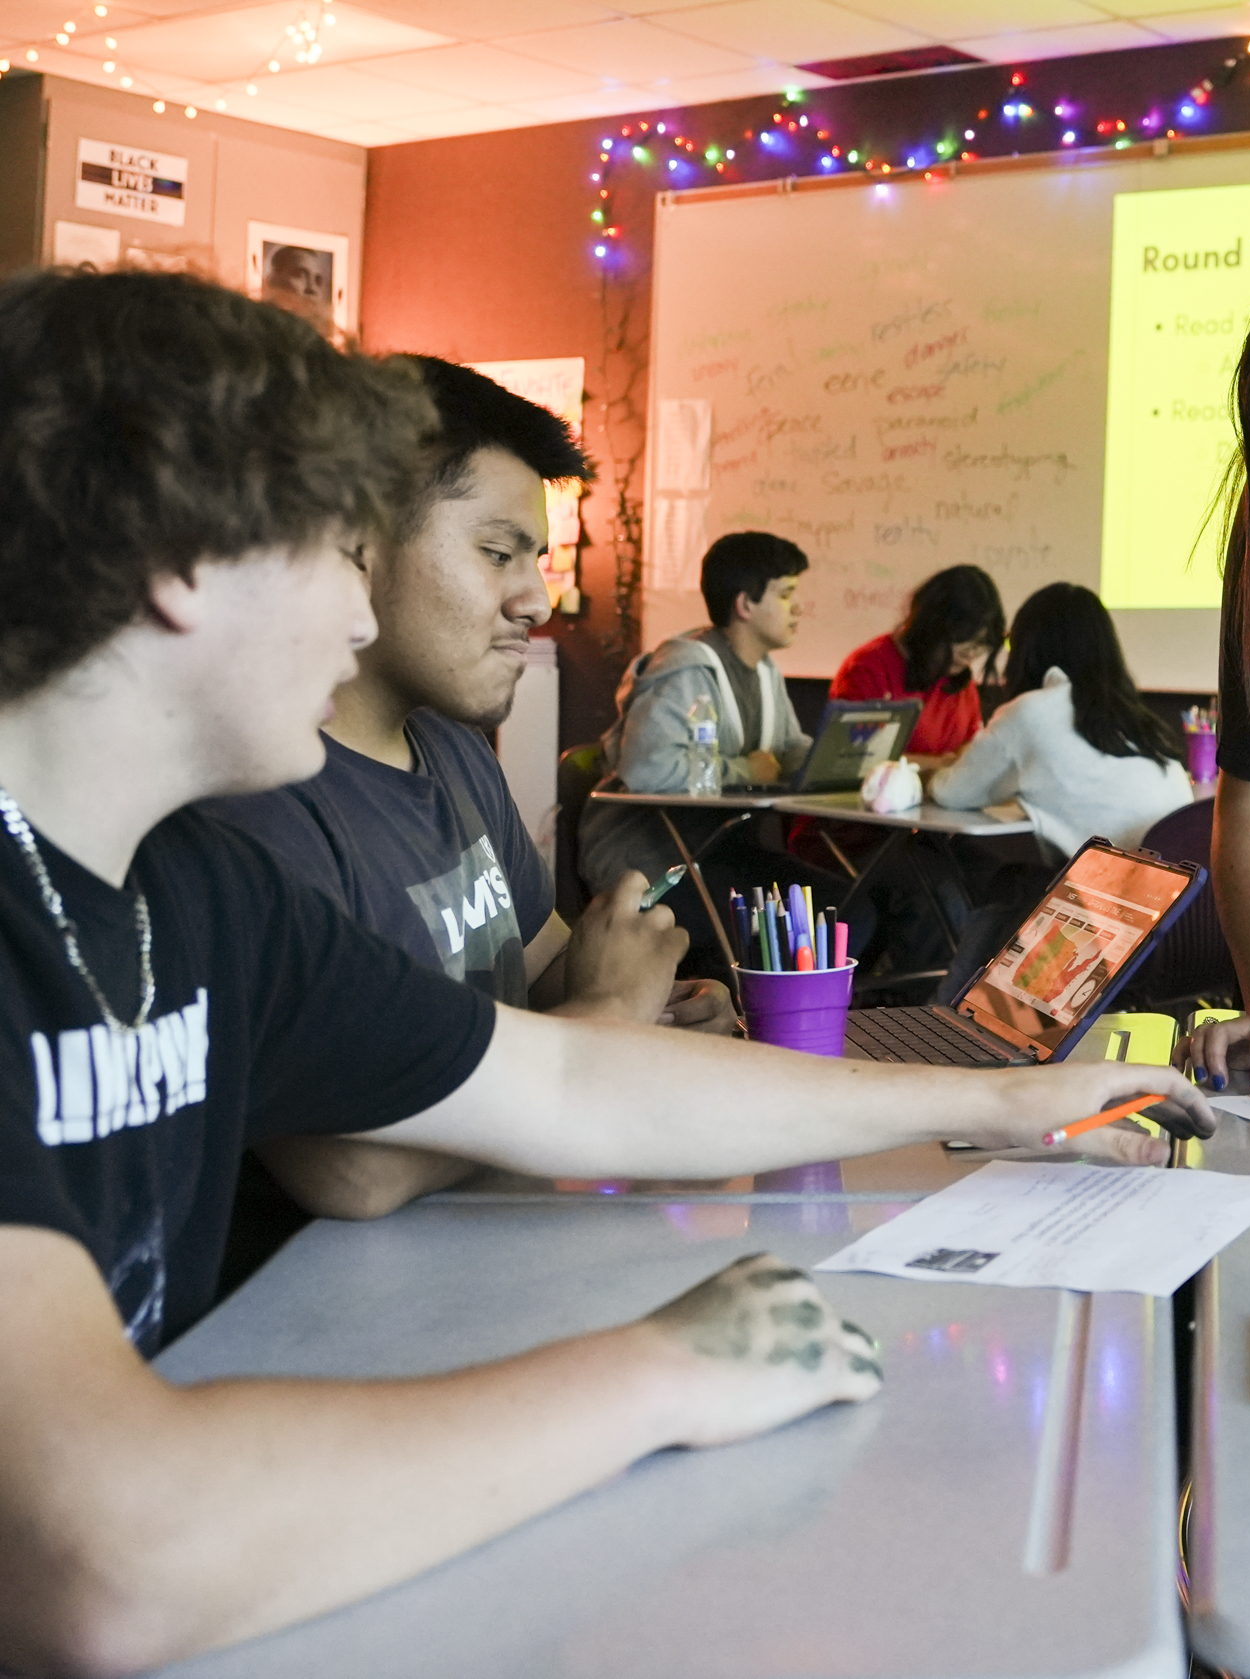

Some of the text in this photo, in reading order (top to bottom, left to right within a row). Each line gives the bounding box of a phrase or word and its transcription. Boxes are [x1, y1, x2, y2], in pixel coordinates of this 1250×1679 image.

[109, 148, 158, 171] BLACK
[111, 168, 154, 194] LIVES
[104, 190, 159, 215] MATTER
[1143, 238, 1242, 272] Round
[1174, 311, 1234, 337] Read
